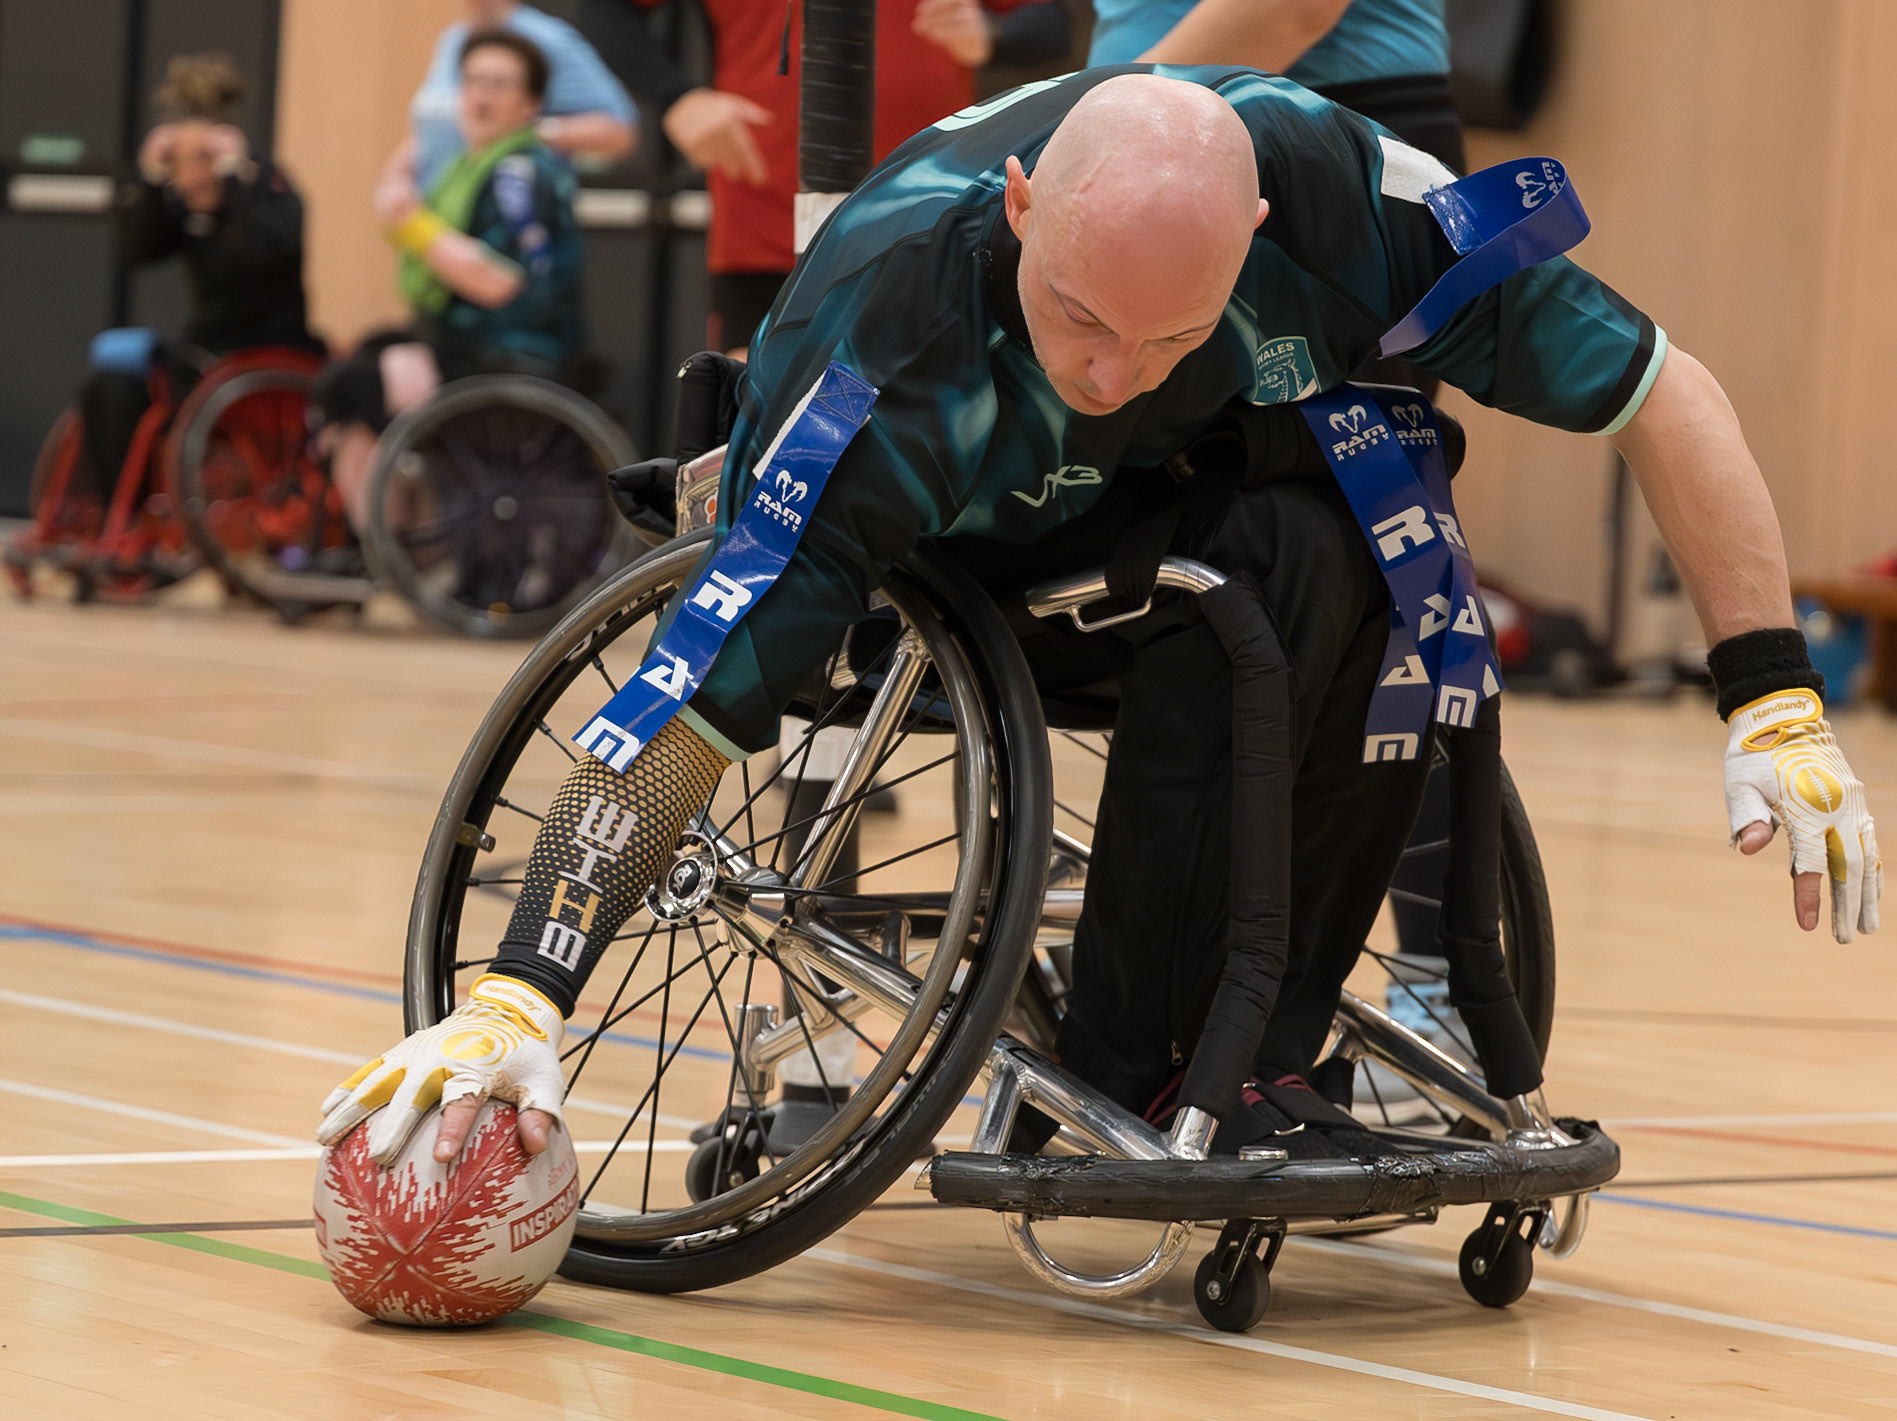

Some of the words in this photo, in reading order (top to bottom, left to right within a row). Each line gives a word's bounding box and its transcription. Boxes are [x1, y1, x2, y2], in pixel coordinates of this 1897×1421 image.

[1332, 424, 1387, 454] RAM
[1336, 432, 1389, 461] RUGBY
[1396, 428, 1436, 440] RAM
[753, 500, 799, 533] RUGBY
[757, 490, 802, 526] RAM
[1752, 699, 1808, 722] Handlandy
